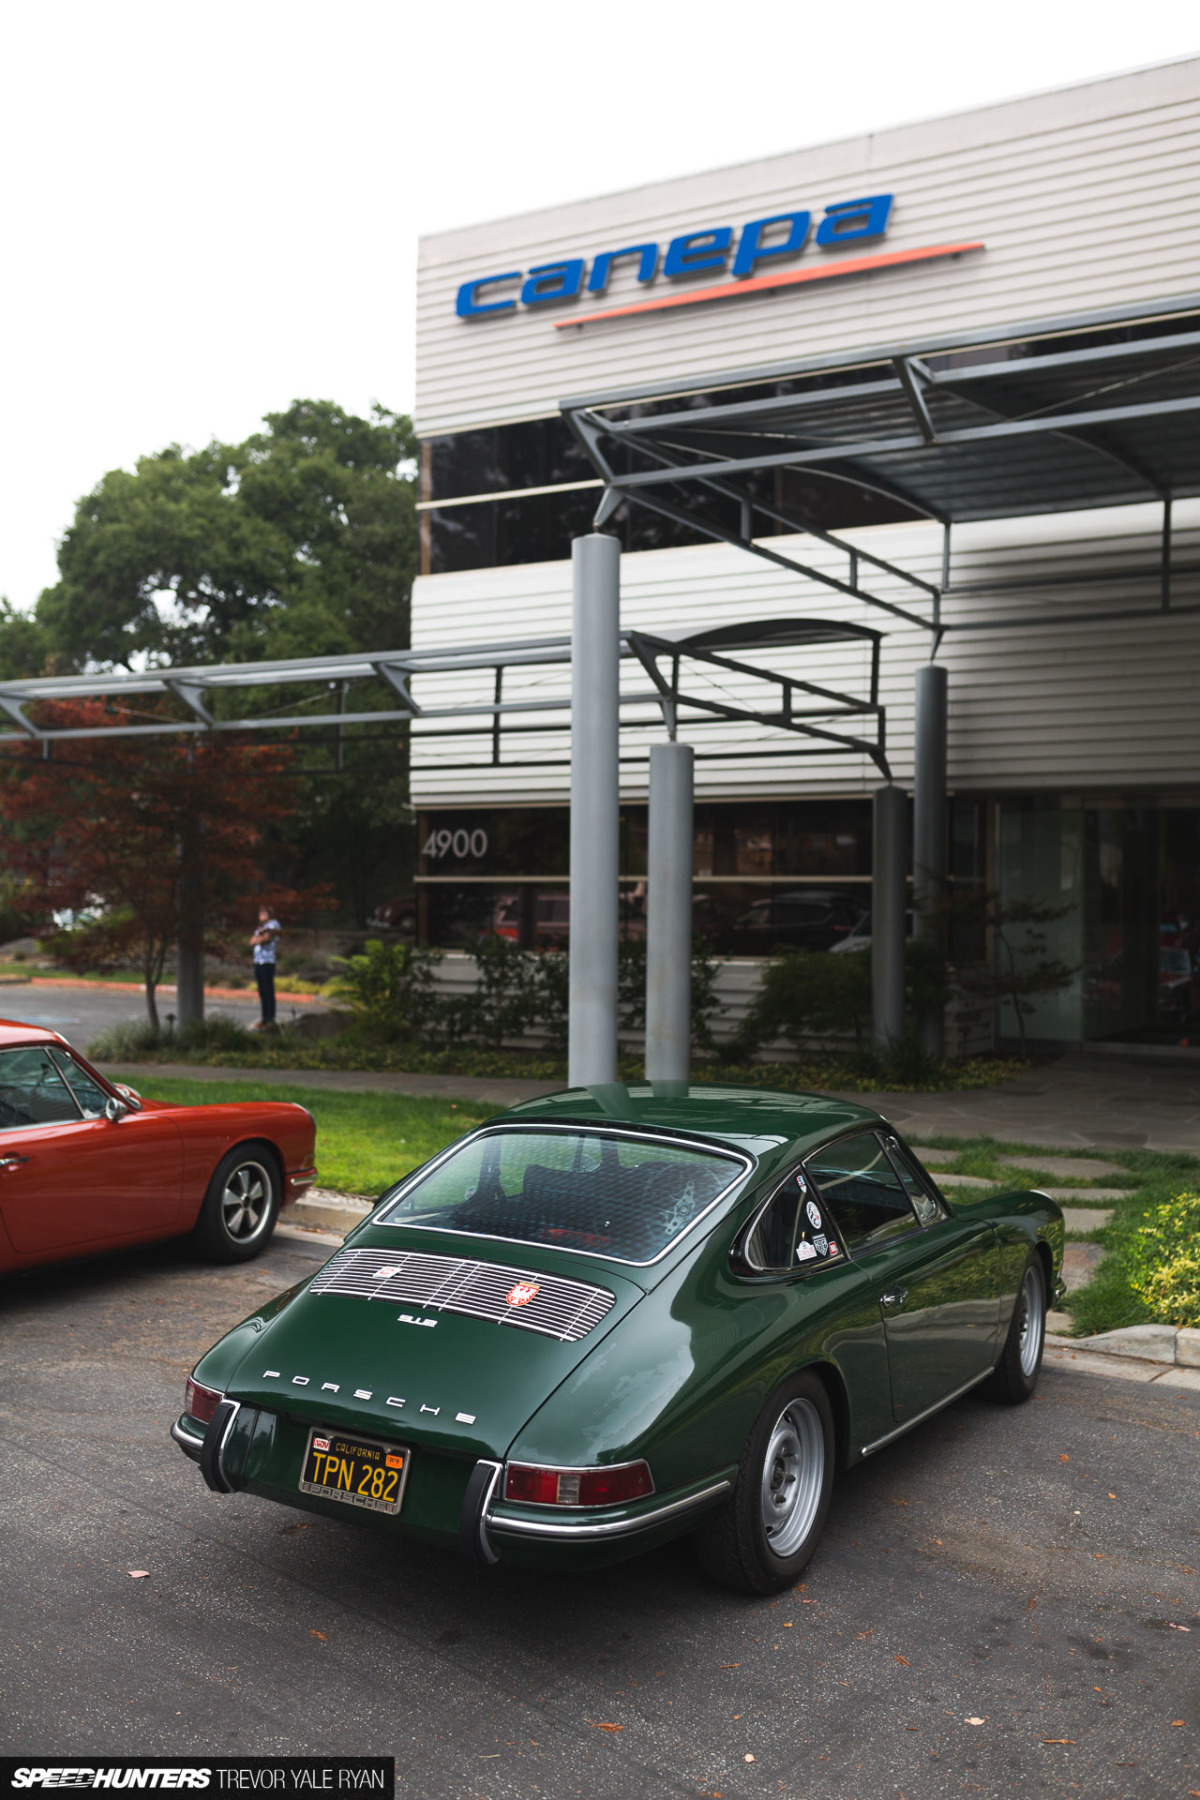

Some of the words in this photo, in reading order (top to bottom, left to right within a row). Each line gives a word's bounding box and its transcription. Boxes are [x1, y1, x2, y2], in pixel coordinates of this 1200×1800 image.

[455, 194, 894, 318] canepa
[421, 829, 488, 858] 4900
[262, 1370, 477, 1425] PORSCHE
[313, 1451, 355, 1491] TPN
[357, 1464, 398, 1503] 282
[335, 1442, 380, 1461] CALIFORNIA
